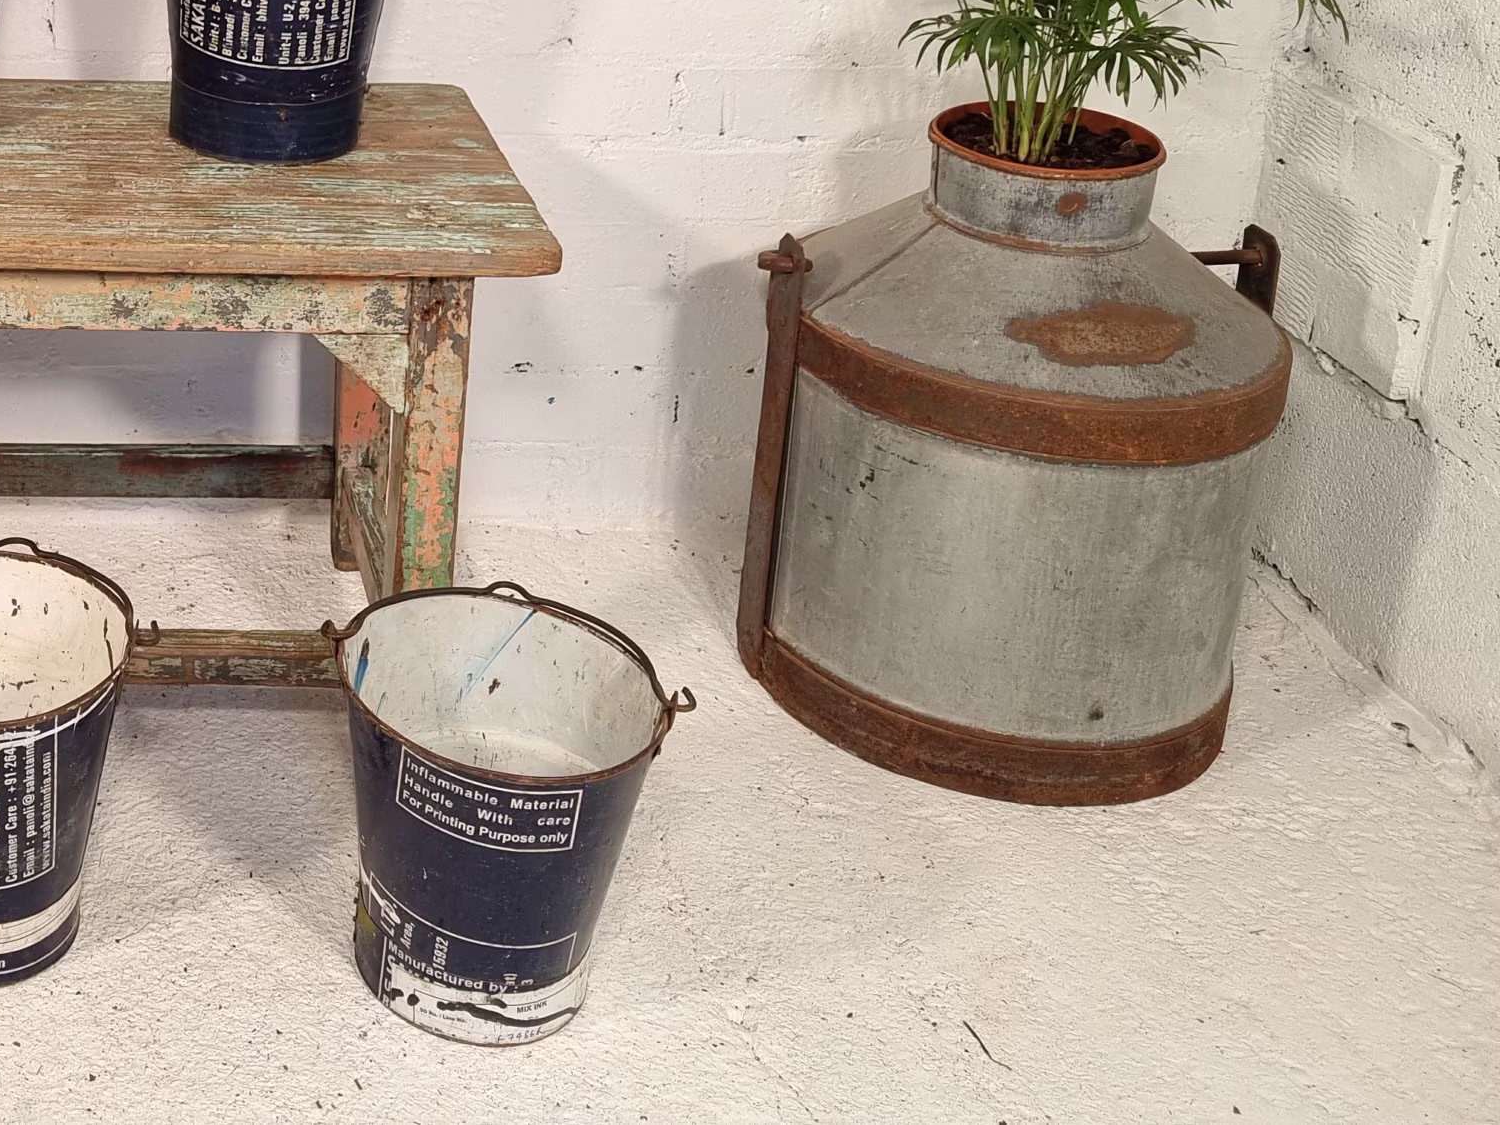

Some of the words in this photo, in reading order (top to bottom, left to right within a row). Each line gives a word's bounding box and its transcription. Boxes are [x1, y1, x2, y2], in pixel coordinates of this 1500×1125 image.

[252, 34, 265, 62] Email
[294, 32, 308, 64] Panoli
[324, 33, 336, 62] Email
[404, 773, 454, 809] Handle
[476, 808, 513, 825] With
[537, 815, 571, 826] care
[406, 758, 498, 806] Inflammable
[510, 798, 574, 811] Material
[4, 805, 18, 830] Care
[402, 789, 423, 809] For
[424, 803, 475, 836] Printing
[478, 826, 536, 844] Purpose
[539, 832, 569, 845] only
[5, 834, 18, 883] Customer
[23, 848, 35, 878] Email
[388, 940, 484, 990] Manufactured
